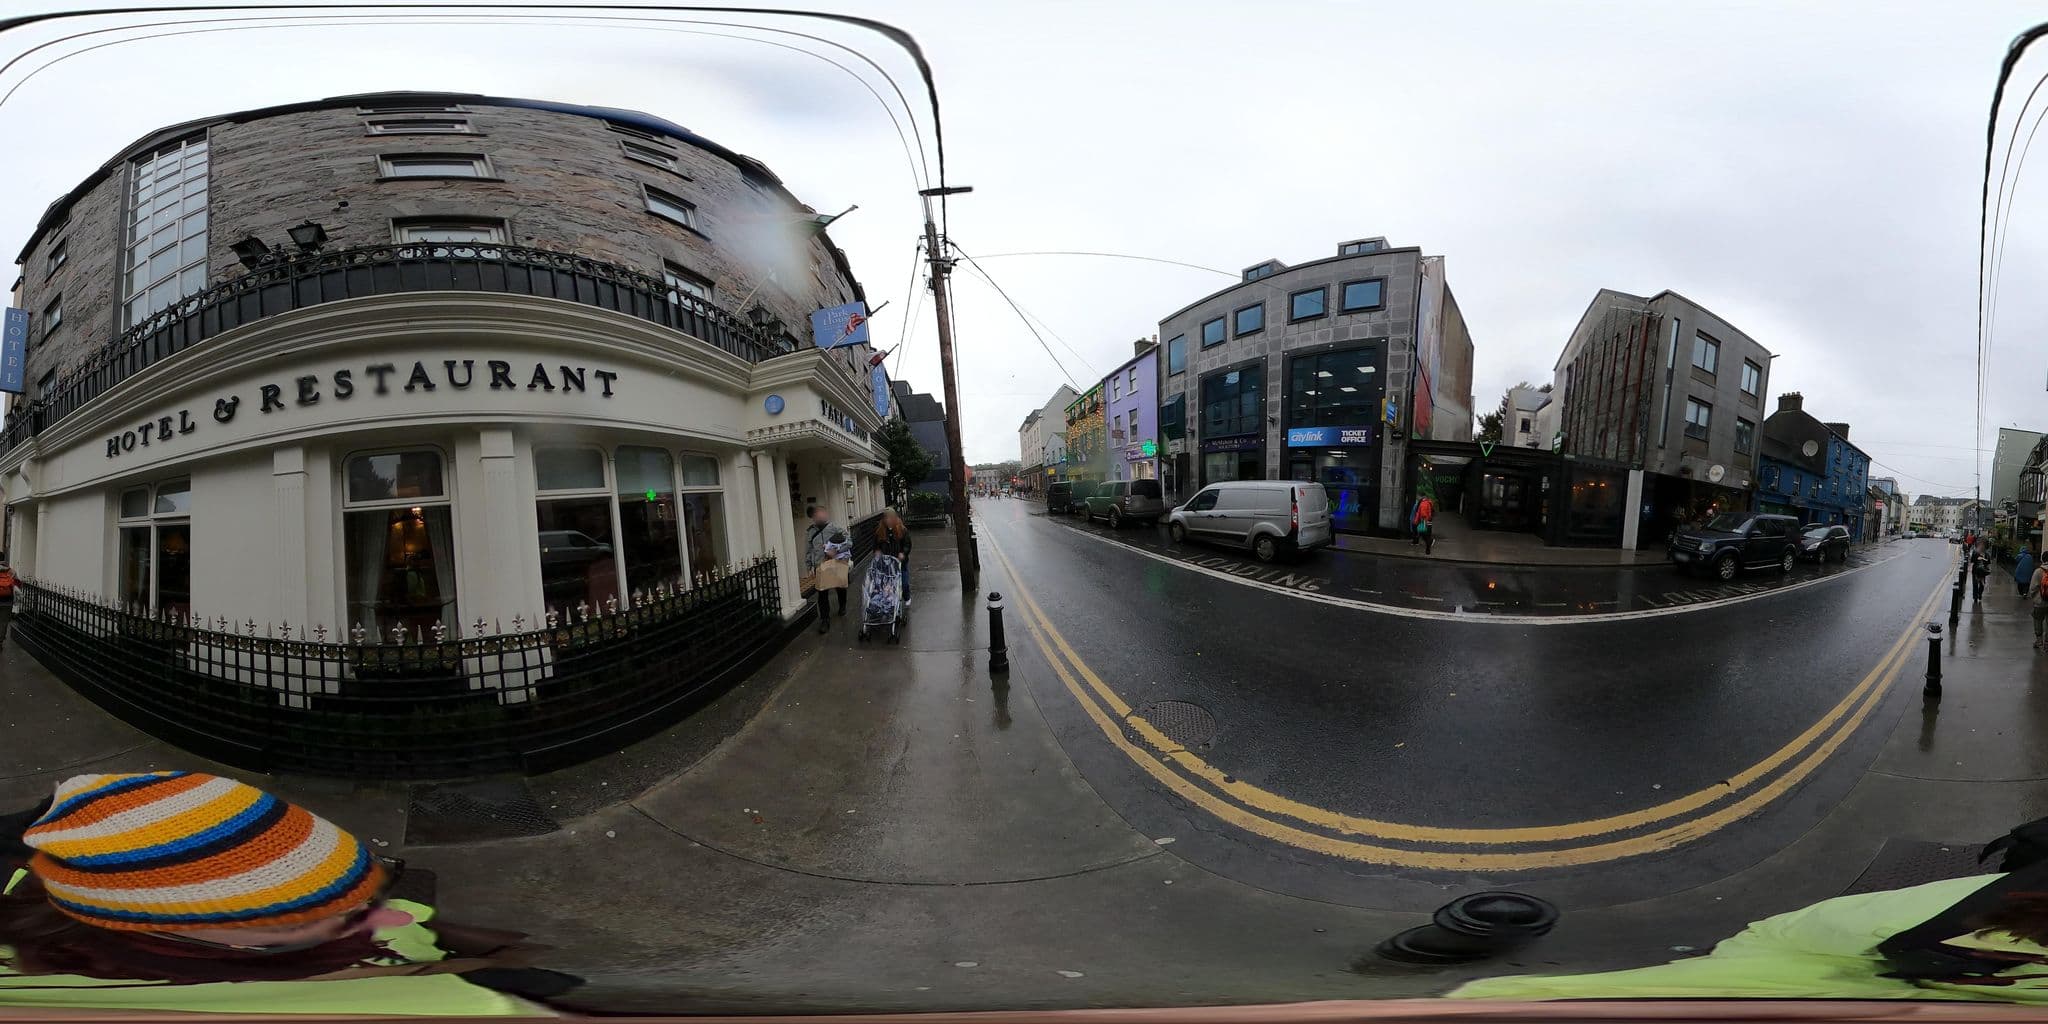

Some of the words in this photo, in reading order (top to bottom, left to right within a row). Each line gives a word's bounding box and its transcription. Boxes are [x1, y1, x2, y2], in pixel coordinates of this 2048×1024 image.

[823, 316, 848, 326] Hous
[827, 309, 849, 321] Park
[7, 312, 23, 384] HOTEL
[106, 410, 196, 458] HOTEL
[213, 395, 240, 423] &
[260, 360, 618, 412] RESTAURANT
[821, 399, 845, 427] PARK
[1291, 431, 1324, 443] citylink
[1341, 429, 1367, 437] TICKET
[1182, 553, 1328, 591] LOADING
